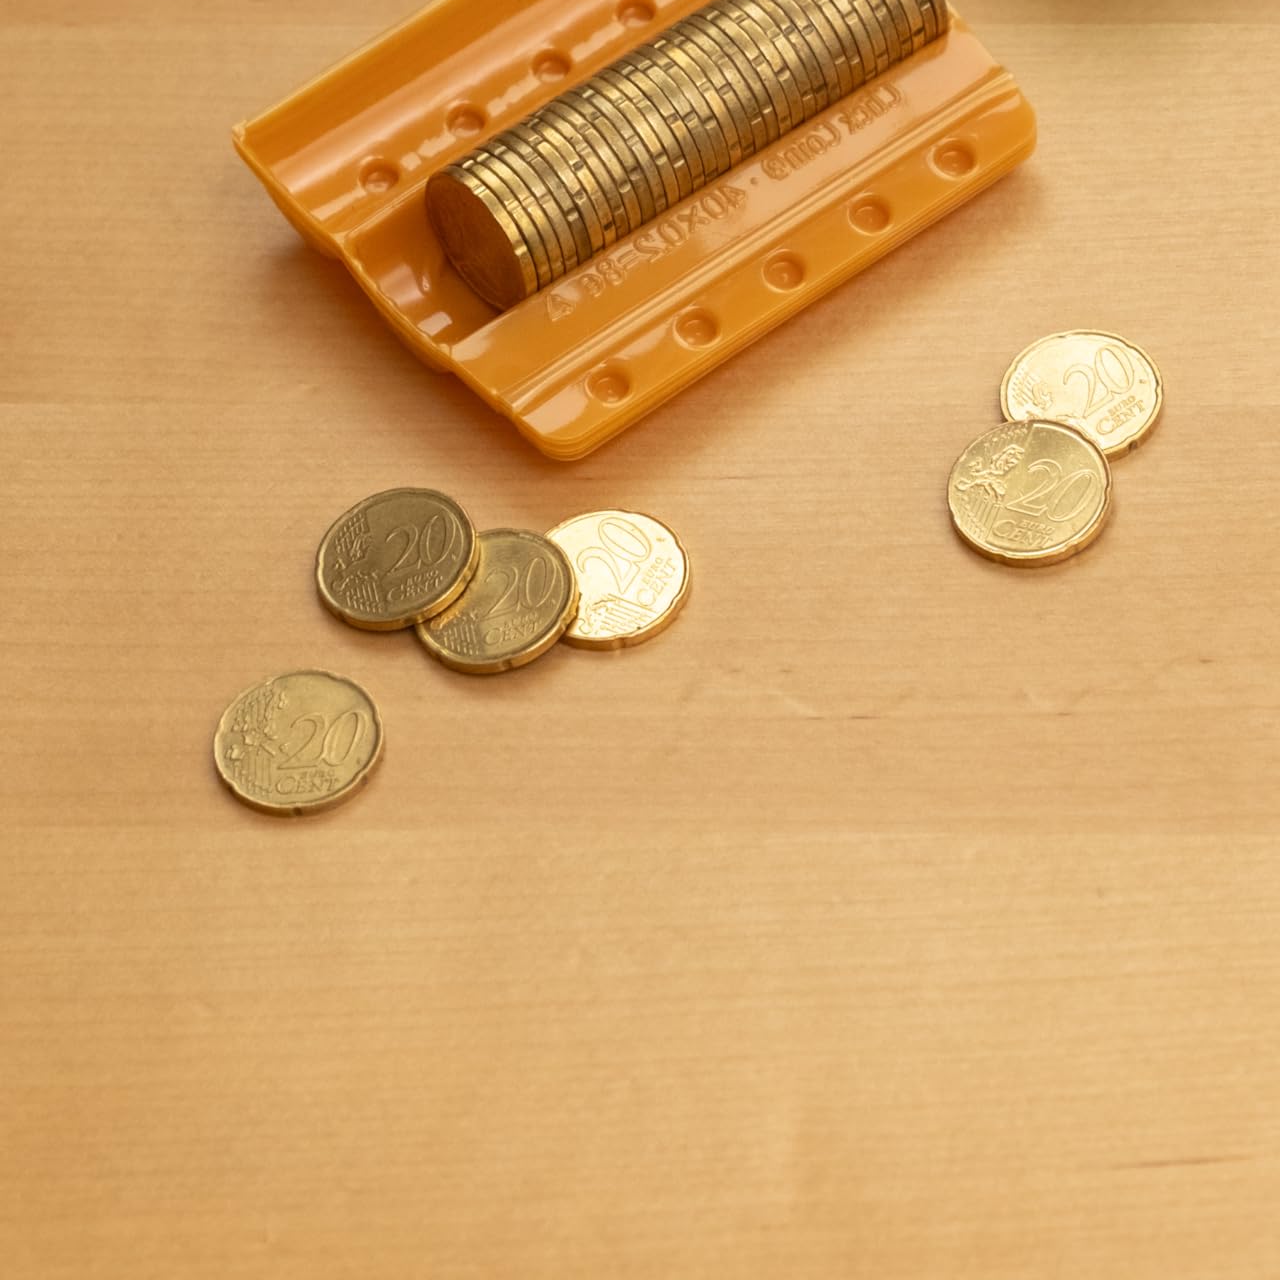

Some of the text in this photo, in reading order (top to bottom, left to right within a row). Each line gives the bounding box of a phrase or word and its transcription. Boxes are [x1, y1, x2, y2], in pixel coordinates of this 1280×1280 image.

[1063, 345, 1135, 419] 20
[1096, 400, 1146, 435] CENT
[1005, 459, 1101, 521] 20
[384, 514, 457, 575] 20
[992, 520, 1053, 547] CENT
[1019, 519, 1055, 534] EURO
[577, 517, 652, 595] 20
[386, 574, 444, 602] CENT
[482, 555, 557, 618] 20
[637, 558, 676, 607] CENT
[484, 618, 542, 646] CENT
[276, 710, 369, 771] 20
[275, 775, 340, 796] CENT
